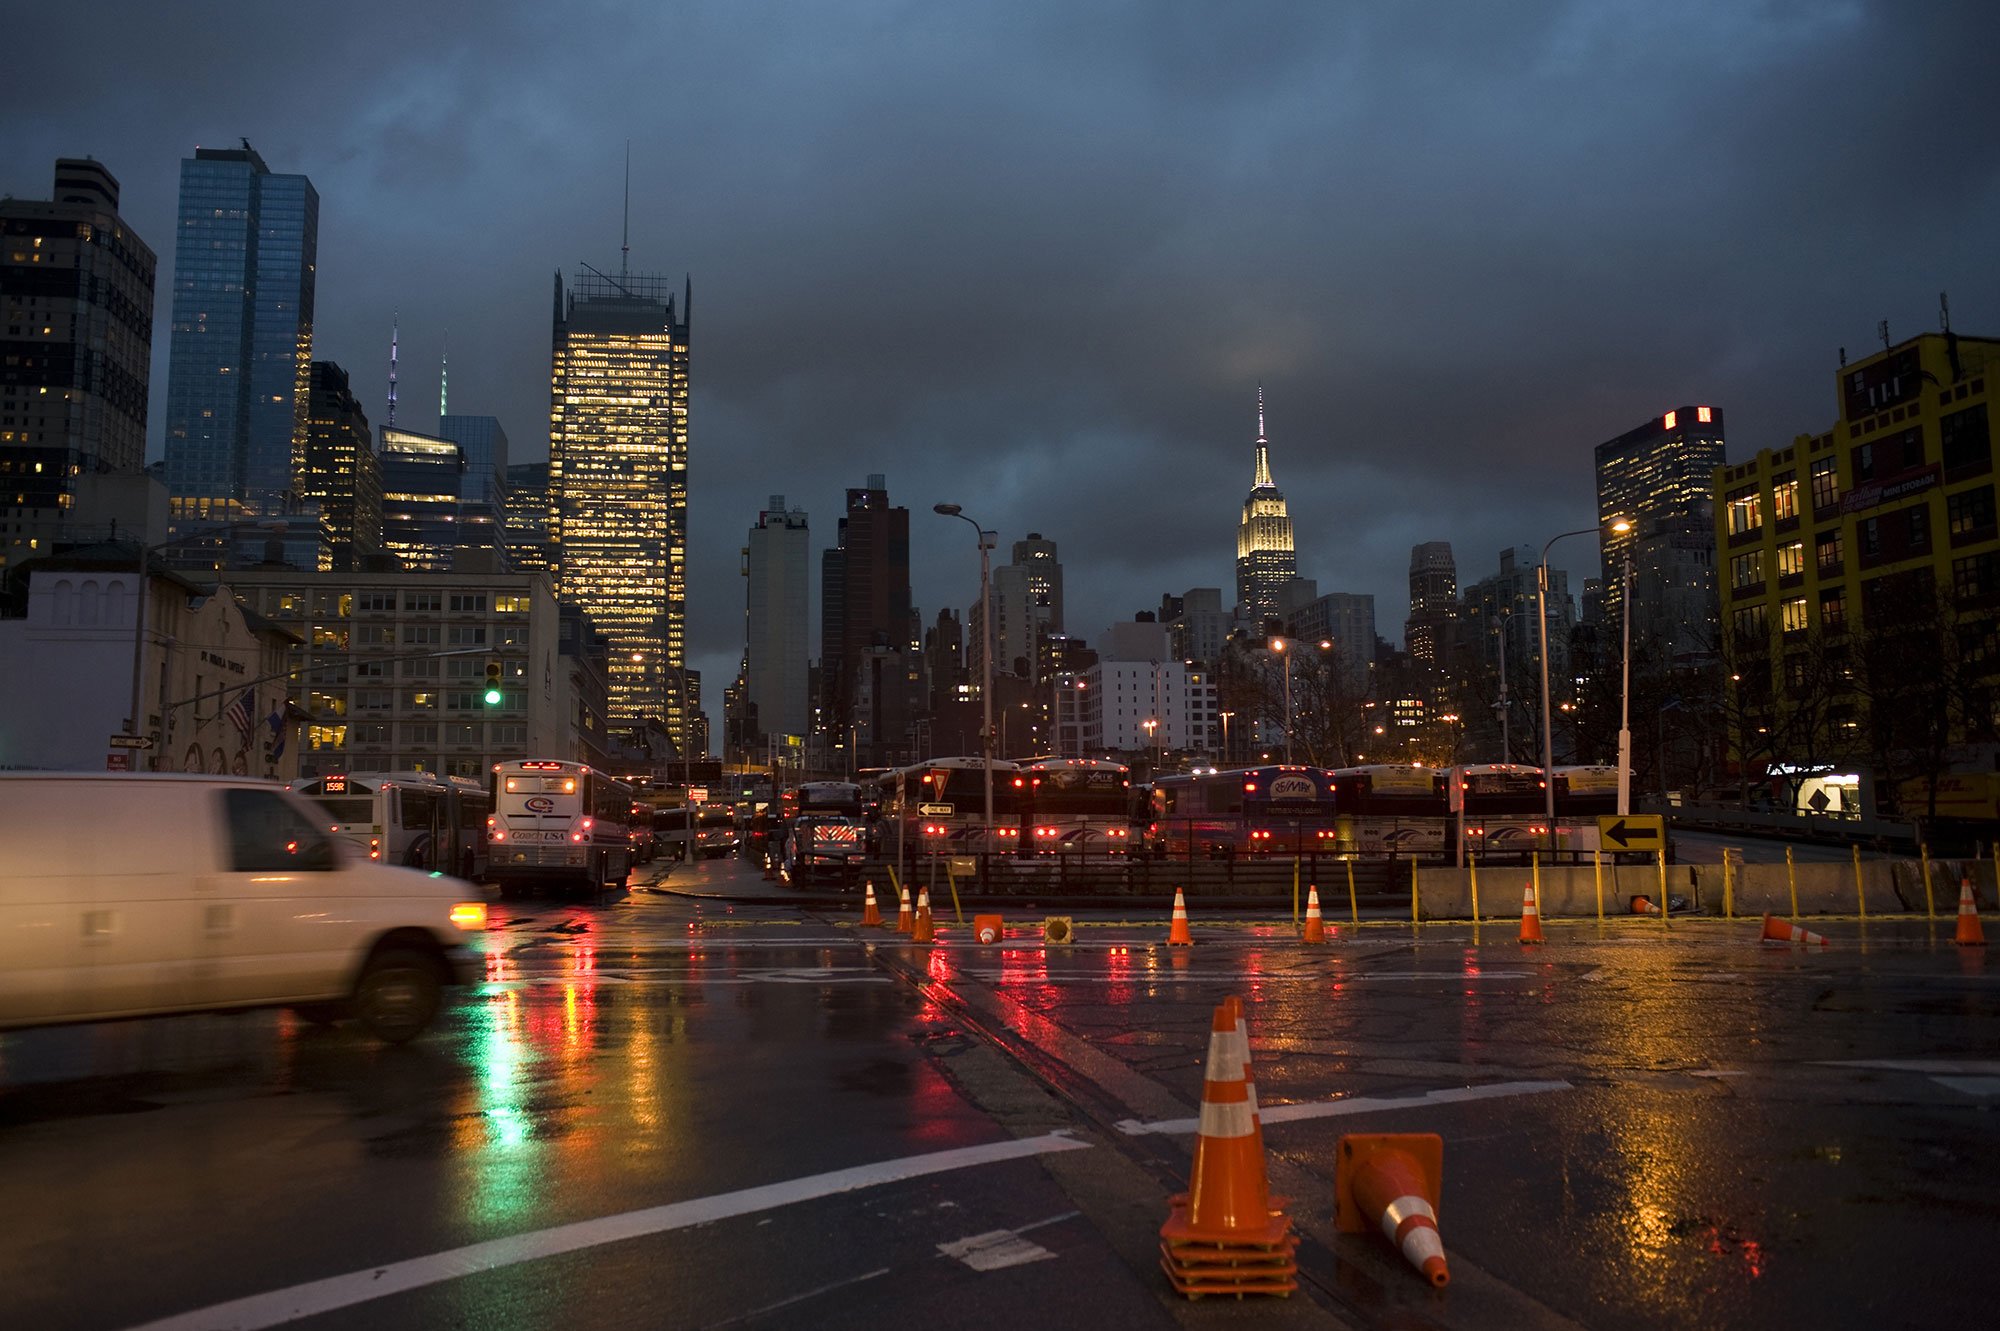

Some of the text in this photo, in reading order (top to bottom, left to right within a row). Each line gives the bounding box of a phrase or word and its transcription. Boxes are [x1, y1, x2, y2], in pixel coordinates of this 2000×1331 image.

[1883, 487, 1901, 498] MINI
[1902, 474, 1936, 492] STORAGE
[326, 782, 345, 792] 159R
[1275, 781, 1311, 793] RE/MAX
[512, 831, 565, 840] Coach USA
